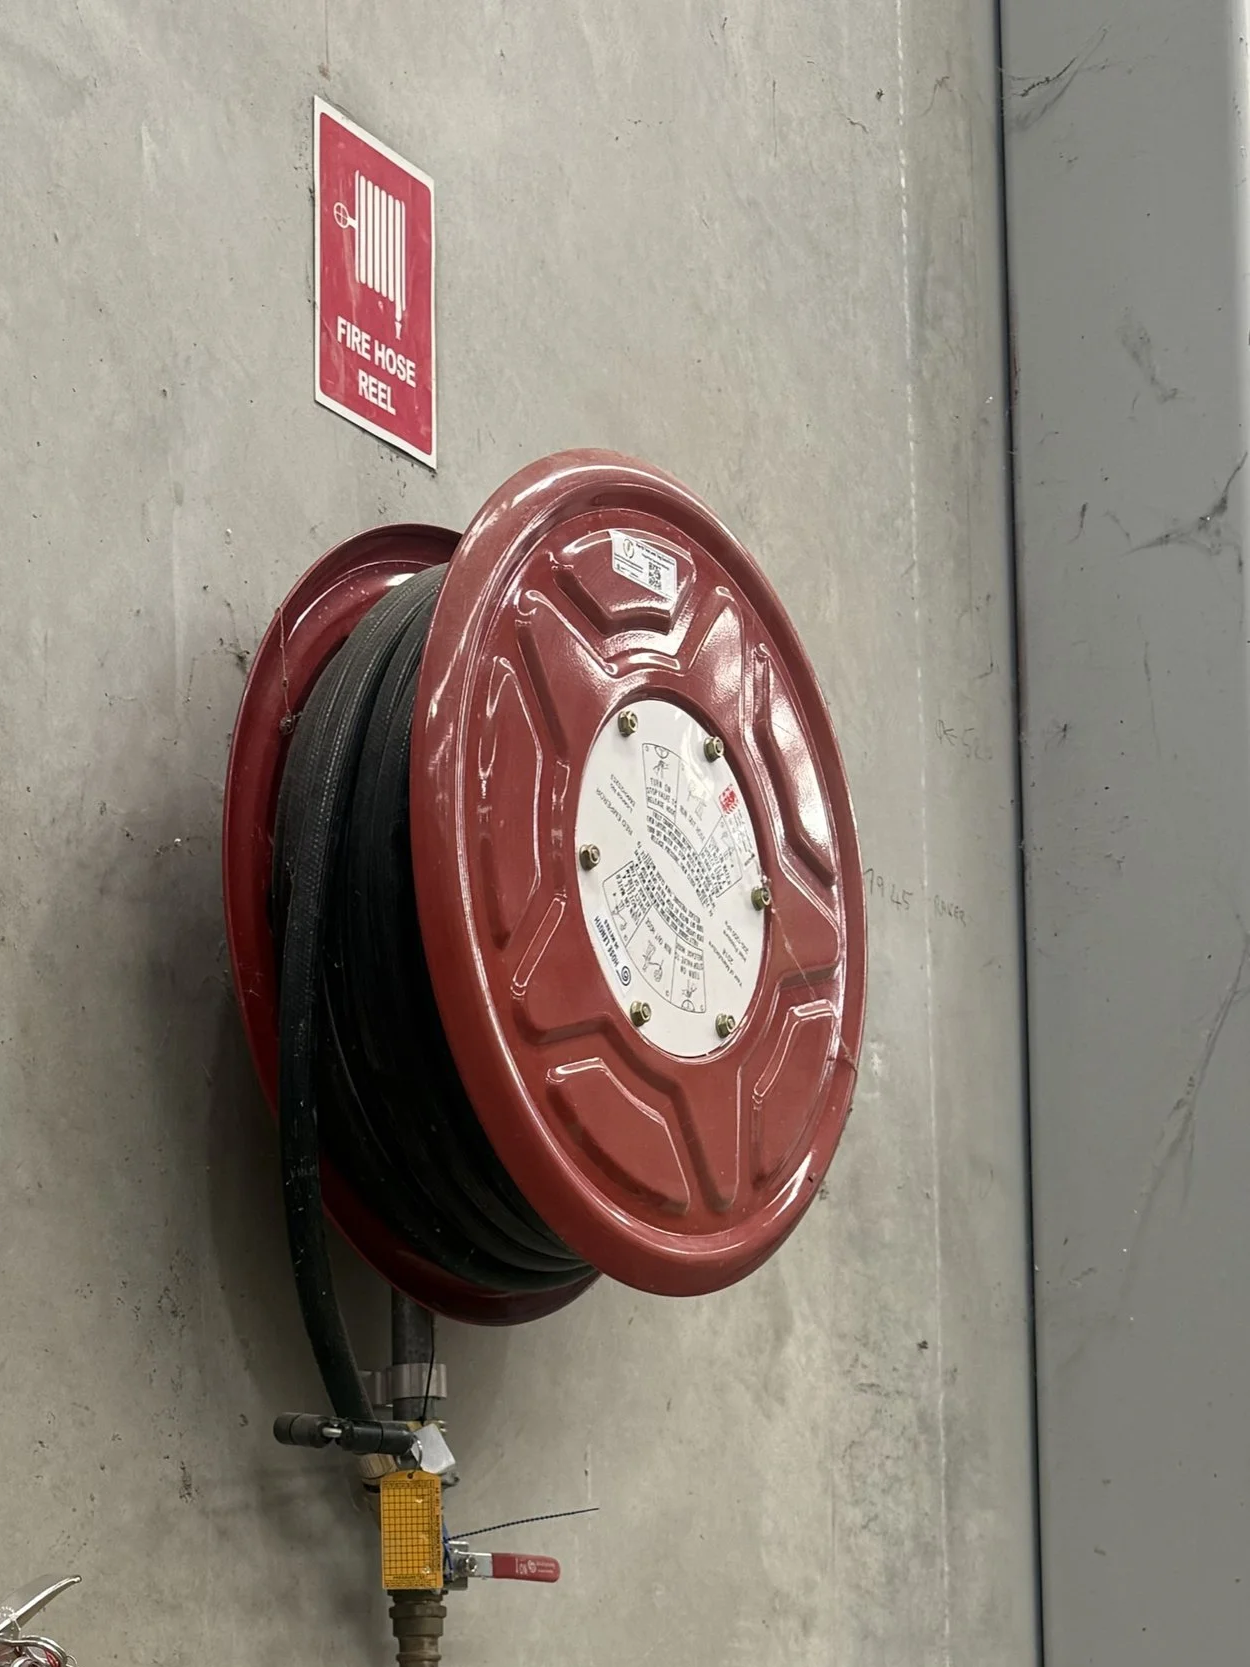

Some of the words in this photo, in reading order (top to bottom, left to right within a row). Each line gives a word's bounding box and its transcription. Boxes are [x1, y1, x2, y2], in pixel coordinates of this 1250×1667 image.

[337, 316, 371, 361] FIRE
[374, 343, 416, 388] HOSE
[358, 370, 396, 415] REEL
[593, 915, 608, 945] LENGTH
[607, 944, 619, 967] HOSE
